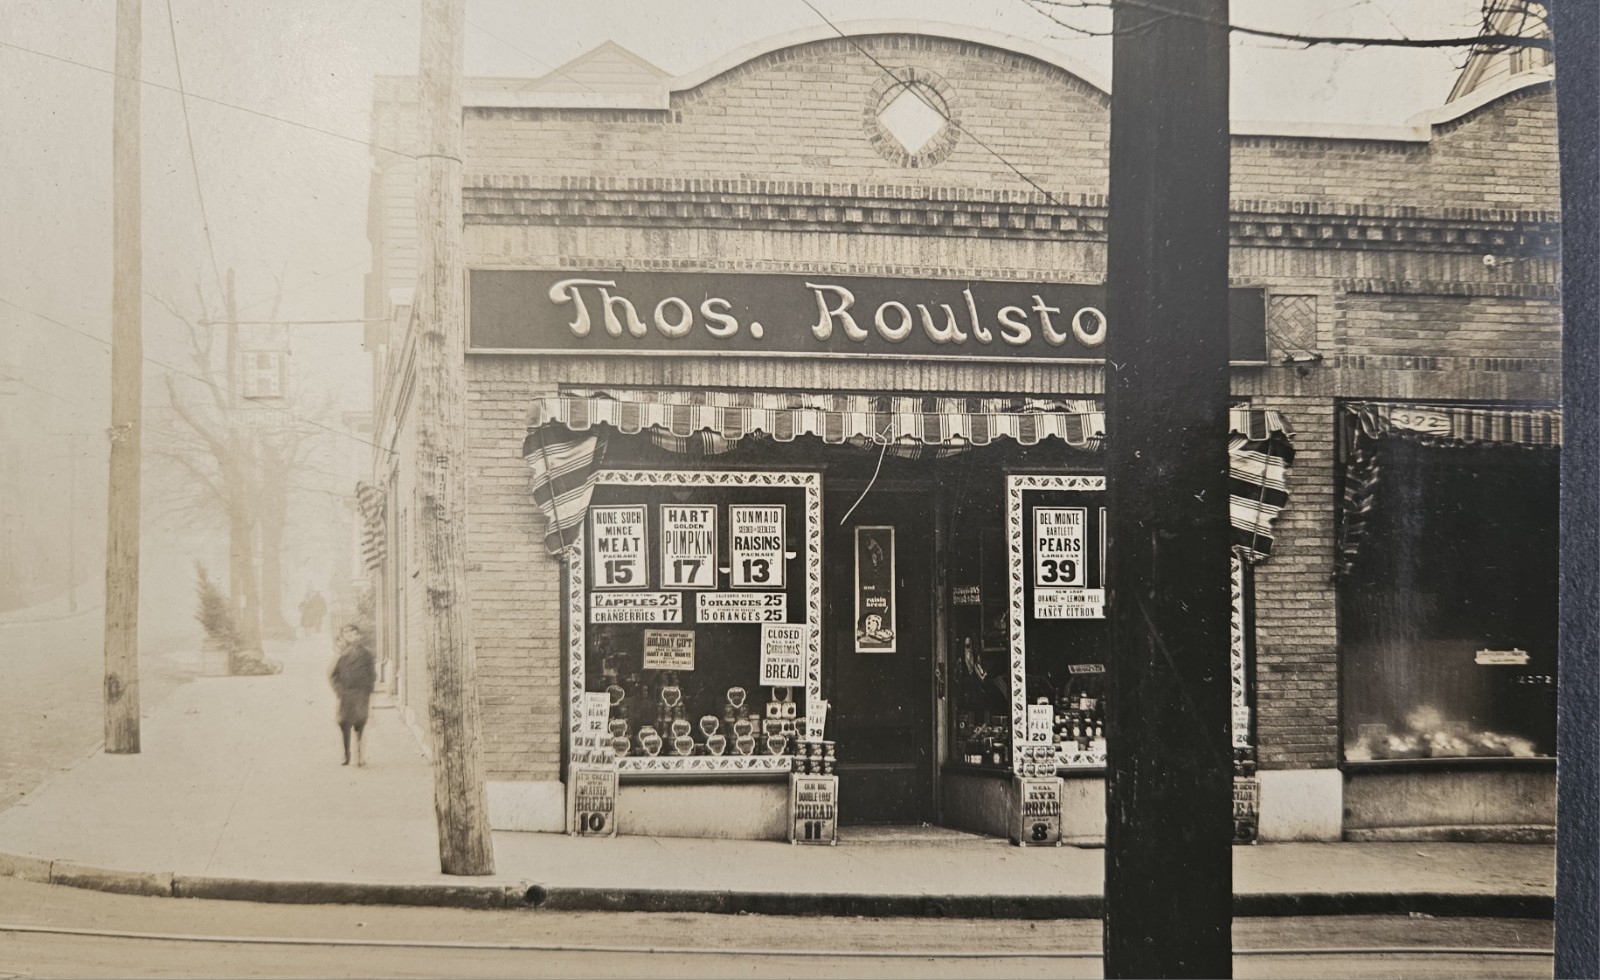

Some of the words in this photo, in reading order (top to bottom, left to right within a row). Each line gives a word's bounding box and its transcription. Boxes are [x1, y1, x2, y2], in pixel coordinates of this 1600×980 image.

[549, 278, 764, 339] Thos.
[805, 281, 1107, 347] Roulsto
[596, 511, 618, 525] NONE
[621, 511, 642, 524] SUCH
[668, 509, 709, 523] HART
[736, 510, 779, 523] SUNMAID
[1040, 513, 1052, 525] DEL
[1055, 513, 1080, 525] MONTE
[605, 526, 633, 536] MINCE
[1046, 527, 1074, 536] BARTLETT
[598, 537, 641, 553] MEAT
[666, 530, 713, 555] PUMPKIN
[734, 536, 781, 551] RAISINS
[1039, 538, 1081, 552] PEARS
[595, 593, 603, 606] 12
[605, 598, 658, 607] APPLES
[659, 594, 678, 606] 25
[700, 594, 706, 606] 6
[764, 594, 783, 606] 25
[595, 612, 656, 622] CRANBERRIES
[662, 609, 678, 621] 17
[701, 608, 710, 621] 15
[712, 612, 761, 621] ORANGES
[764, 609, 783, 621] 25
[1038, 607, 1063, 617] FANCY
[1066, 607, 1095, 617] CITRON
[768, 629, 800, 639] CLOSED
[647, 637, 675, 647] HOLIDAY
[676, 637, 692, 648] GIFT
[767, 643, 800, 655] CHRISTMAS
[766, 664, 800, 679] BREAD
[1030, 720, 1049, 729] PEAS
[810, 728, 823, 737] 39
[1032, 732, 1047, 742] 20
[584, 785, 607, 796] RAISIN
[1028, 791, 1056, 800] RYE
[577, 795, 613, 812] BREAD
[1024, 801, 1059, 817] BREAD
[1235, 802, 1256, 817] EA
[796, 804, 833, 820] BREAD
